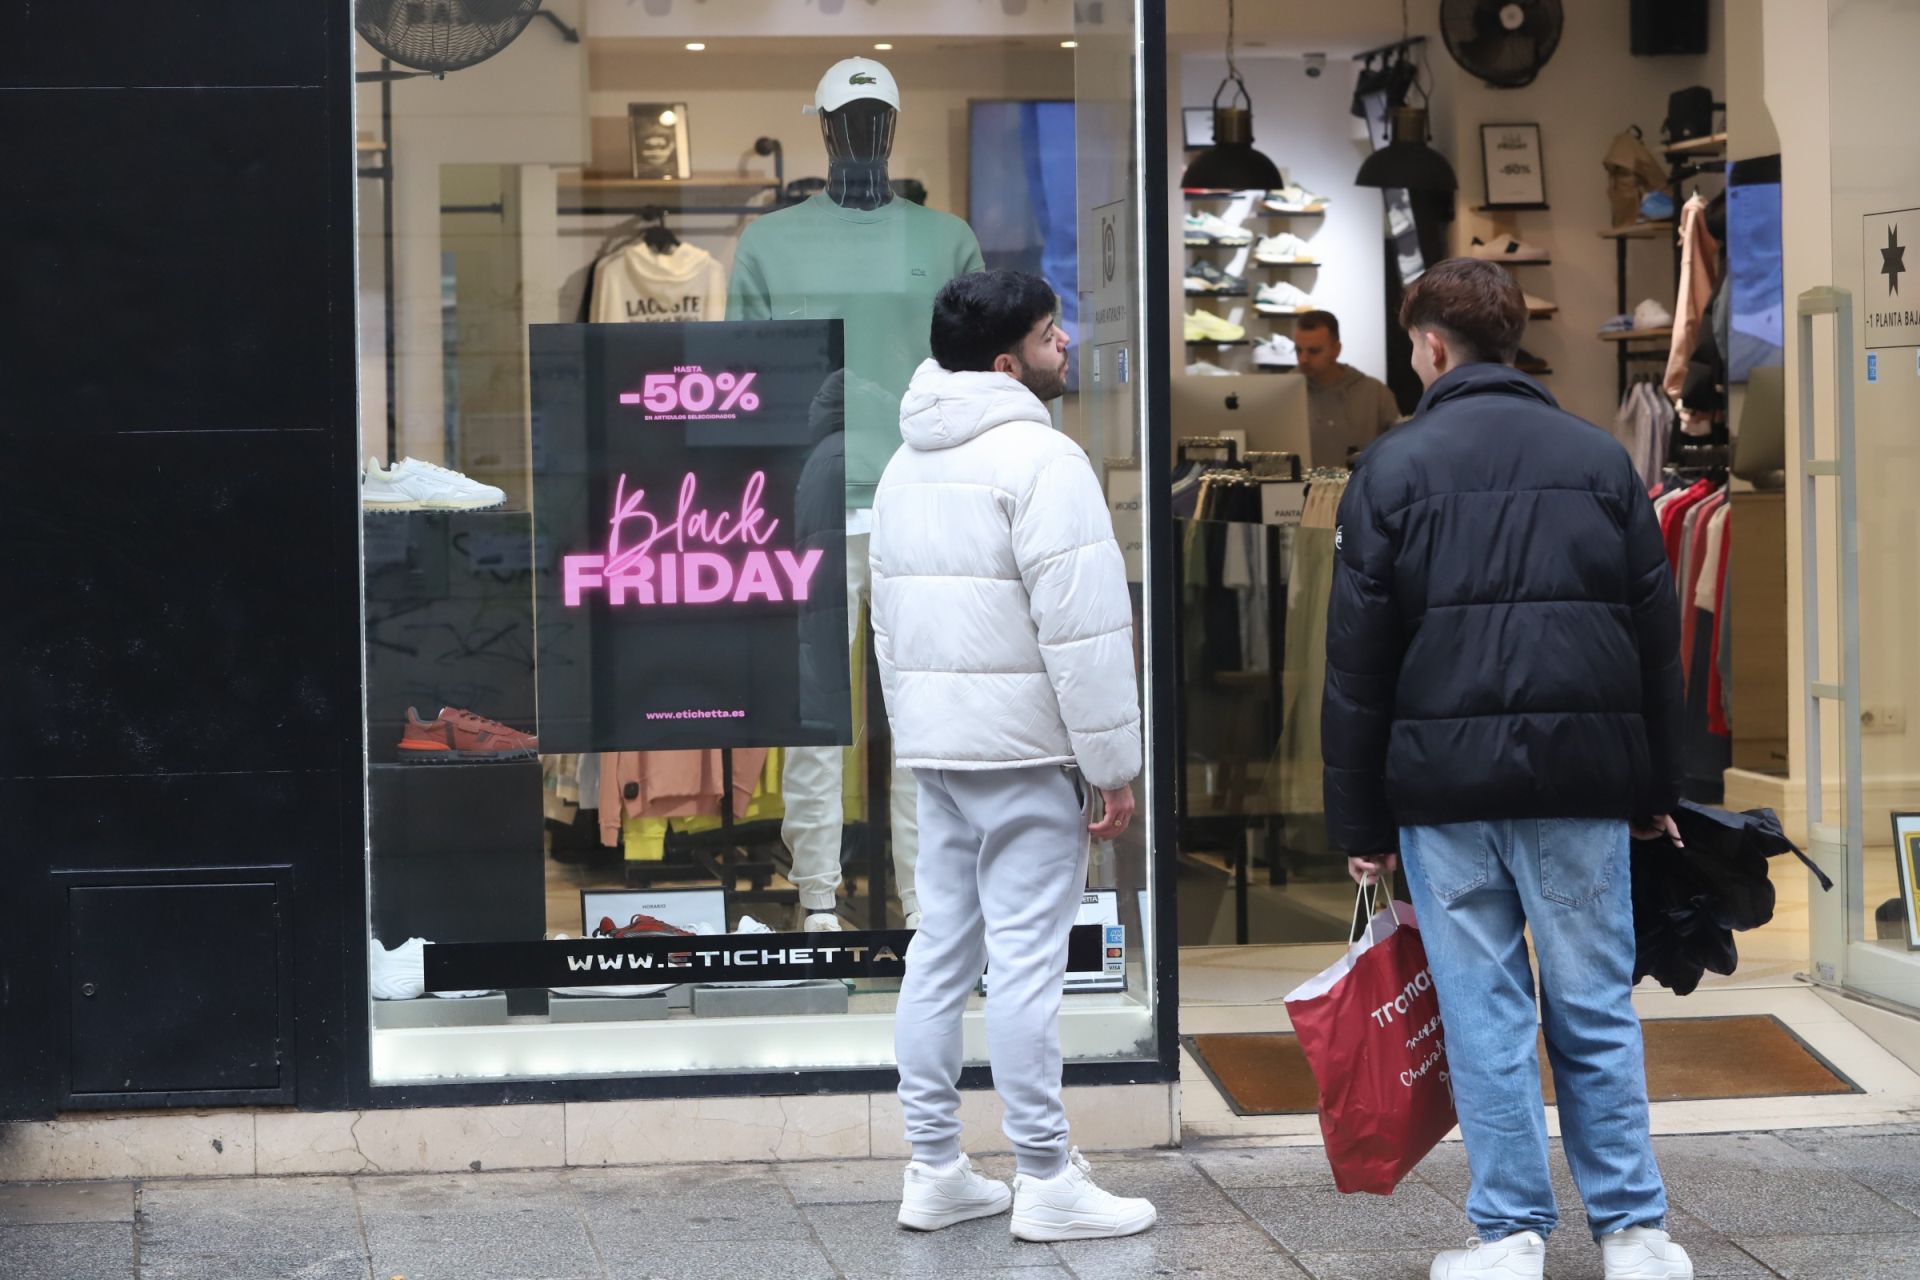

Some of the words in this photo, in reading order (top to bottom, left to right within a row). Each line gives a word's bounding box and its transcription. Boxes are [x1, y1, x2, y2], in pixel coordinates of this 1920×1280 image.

[1875, 312, 1902, 327] PLANTA
[673, 365, 702, 373] HASTA
[619, 372, 760, 413] -50%
[603, 470, 779, 577] Black
[564, 549, 824, 607] FRIDAY
[646, 709, 746, 720] www.etichetta.es
